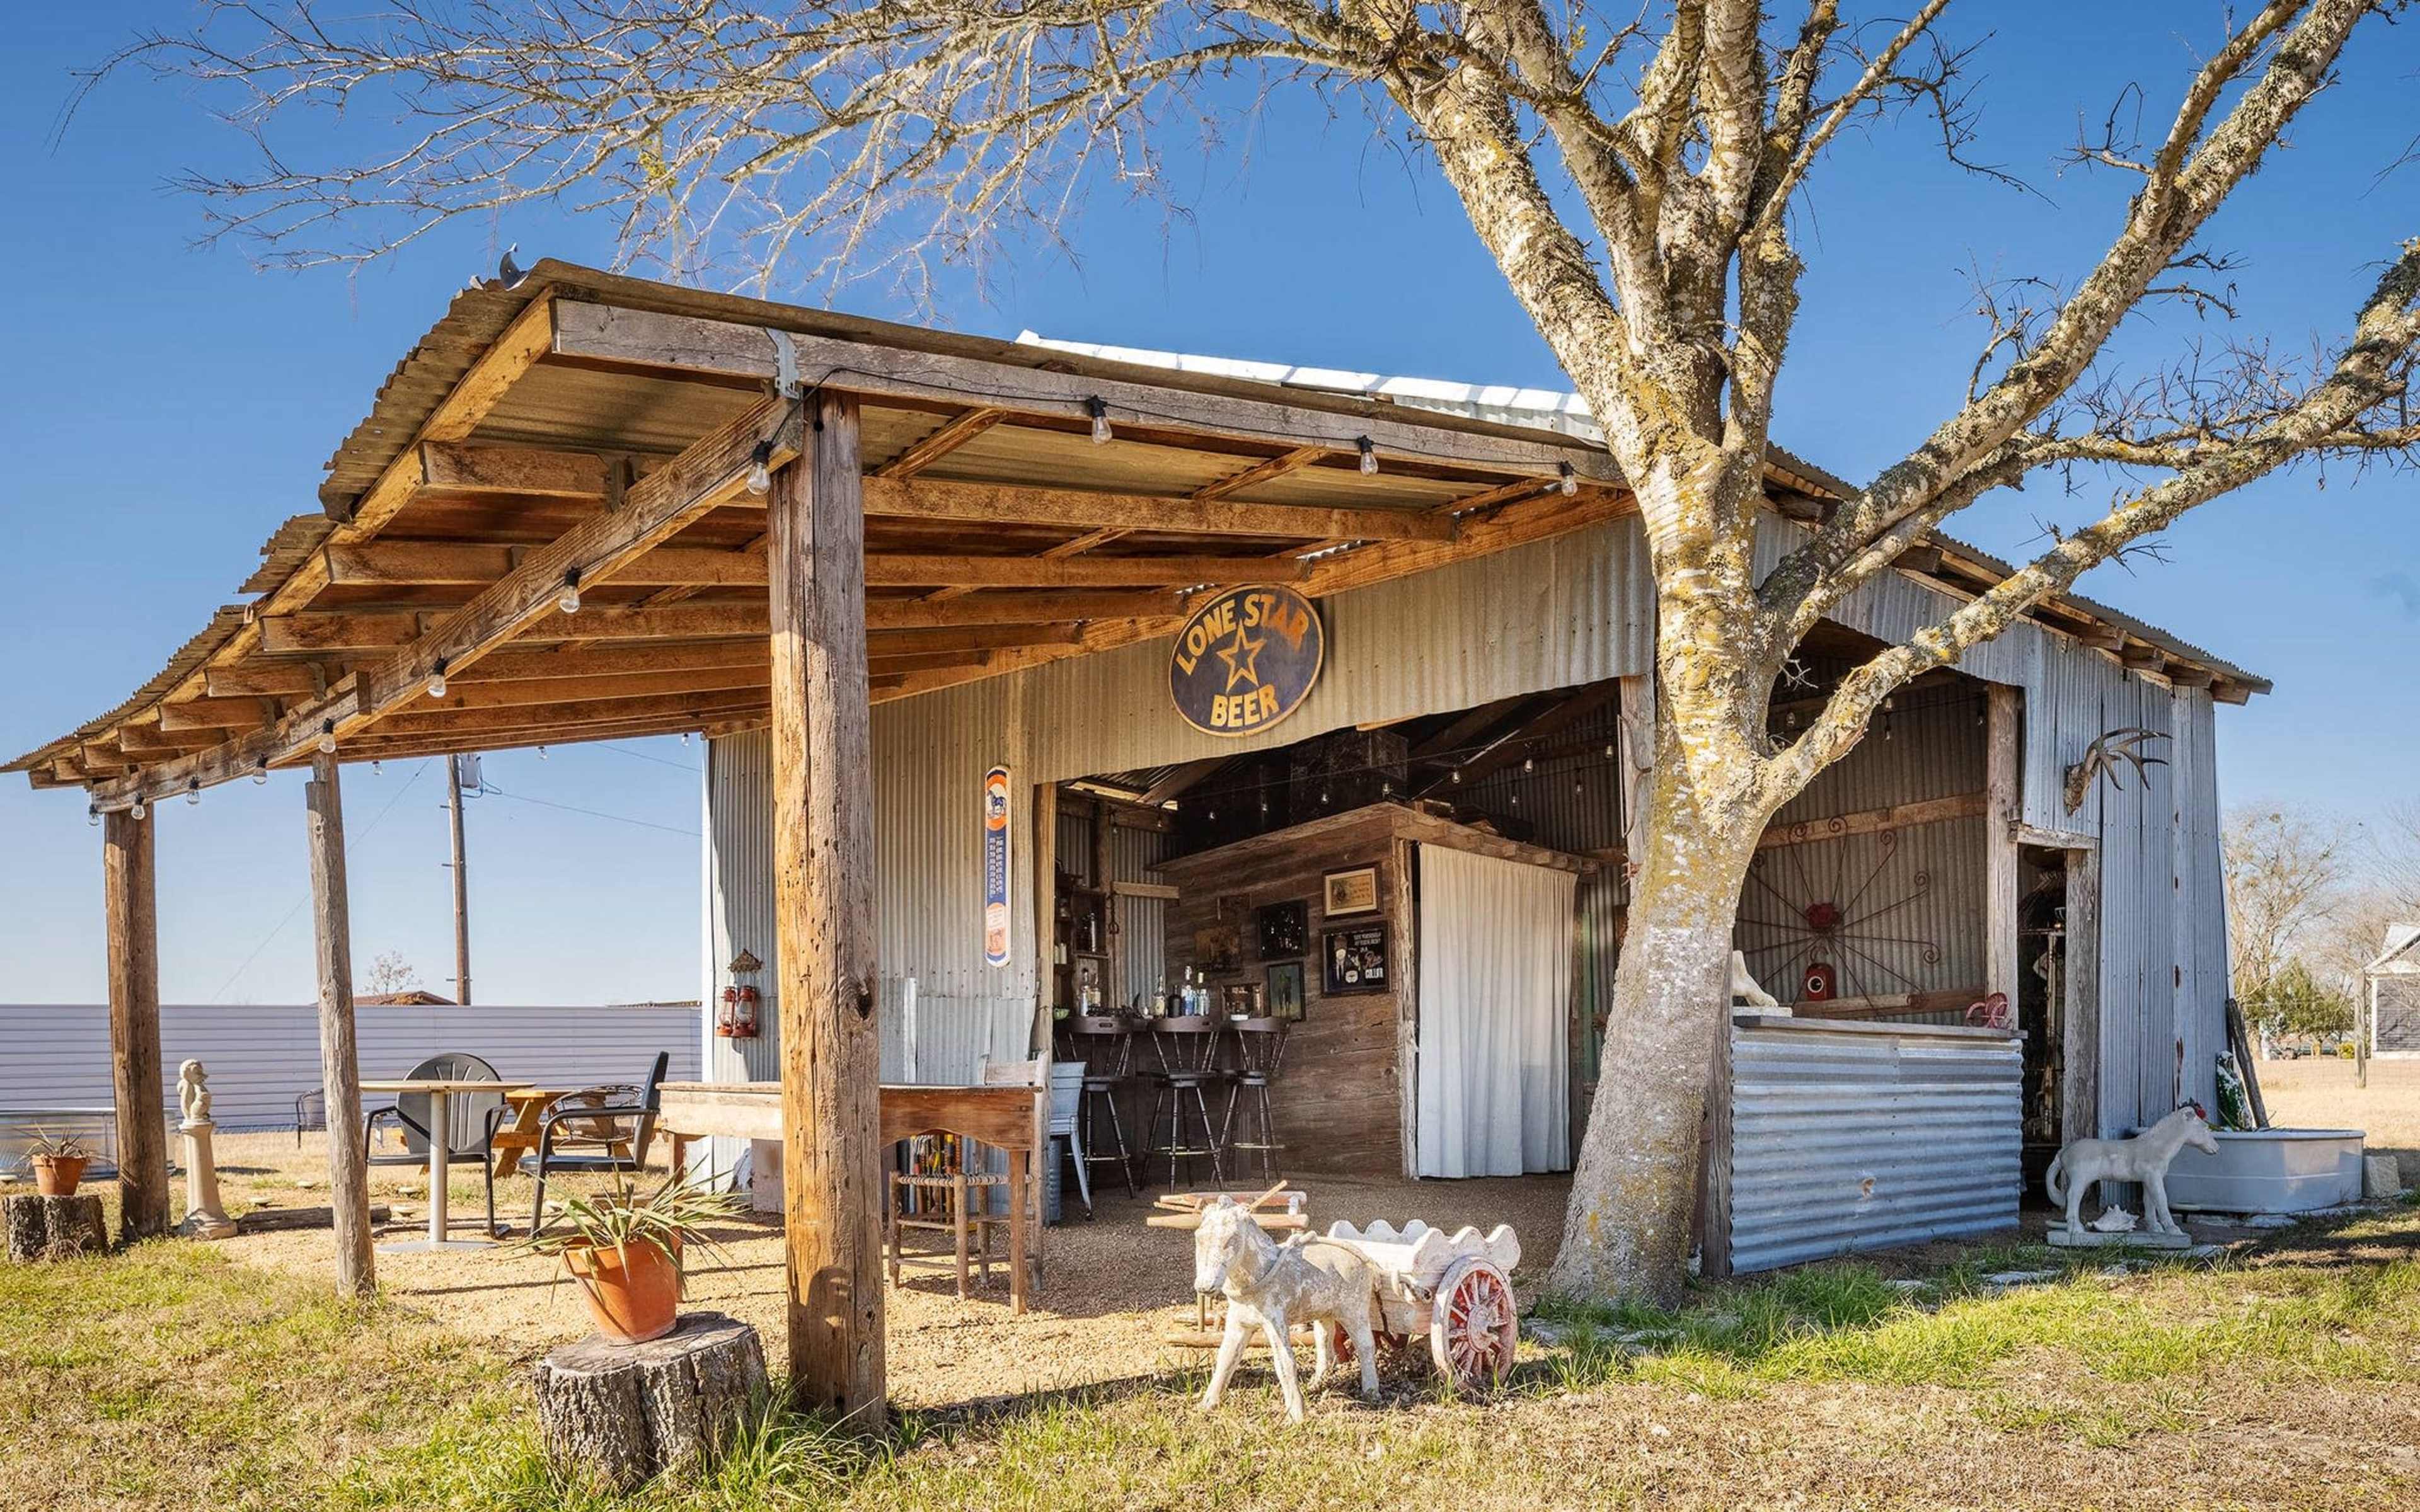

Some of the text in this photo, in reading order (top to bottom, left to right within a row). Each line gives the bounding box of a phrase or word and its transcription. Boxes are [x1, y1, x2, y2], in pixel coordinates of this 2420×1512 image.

[1175, 593, 1309, 676] LONE STAR
[1210, 684, 1280, 727] BEER
